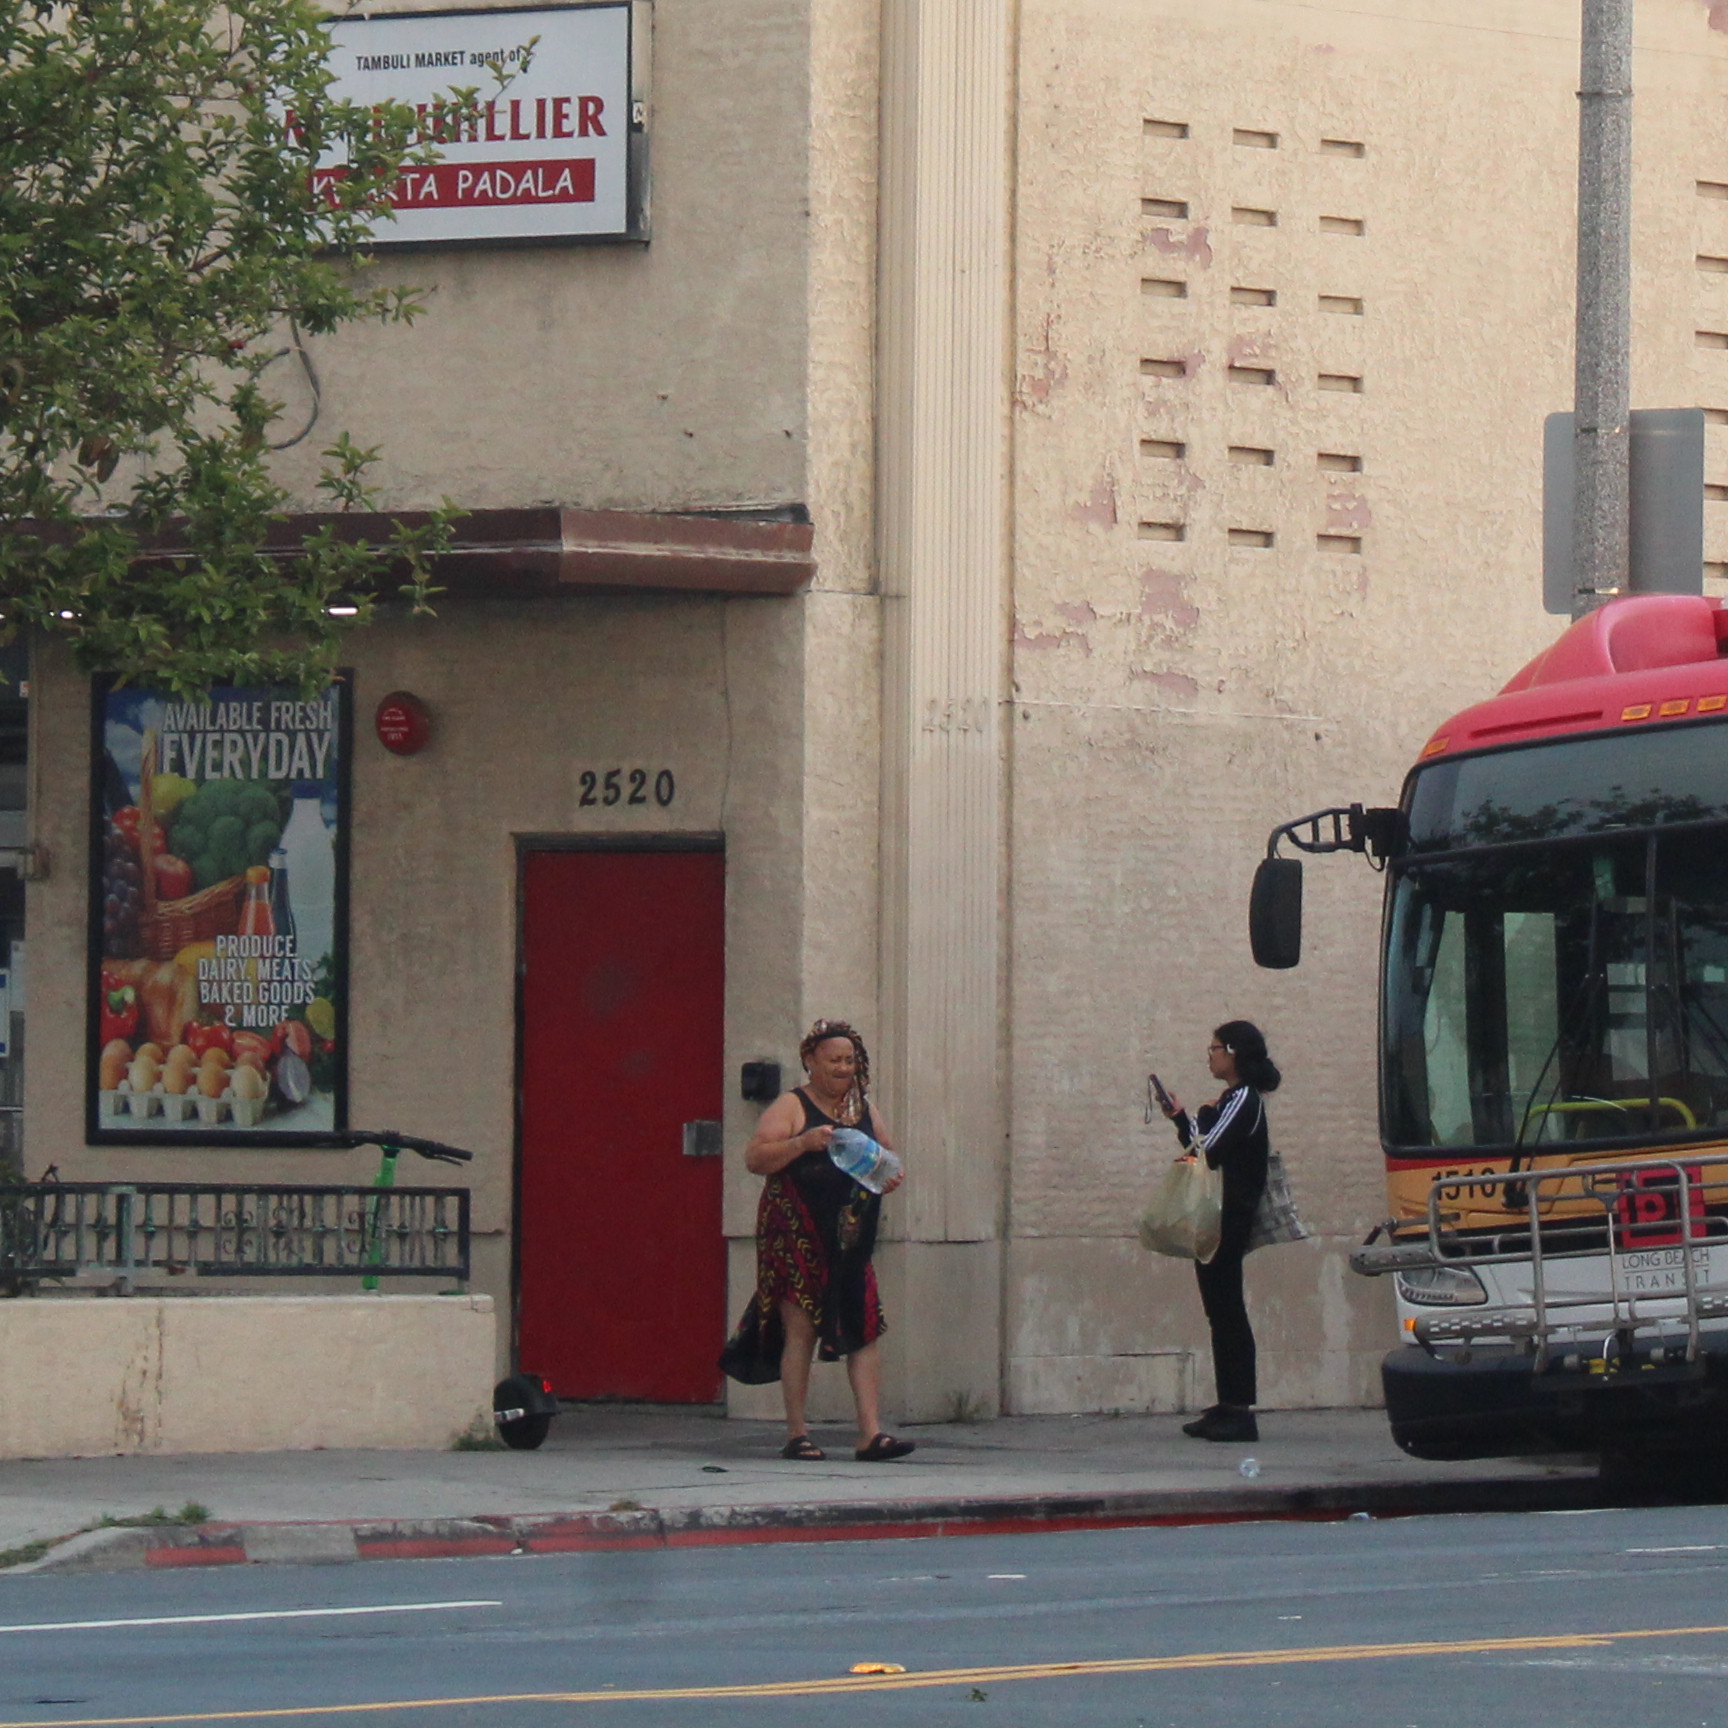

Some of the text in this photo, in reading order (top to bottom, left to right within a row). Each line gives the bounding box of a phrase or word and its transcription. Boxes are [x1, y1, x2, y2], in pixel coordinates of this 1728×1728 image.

[356, 48, 521, 71] TAMBULI MARKET agent of
[458, 168, 574, 199] PADALA
[162, 700, 333, 731] AVAILABLE FRESH
[161, 731, 333, 781] EVERYDAY
[579, 768, 675, 807] 2520
[200, 982, 316, 1004] BAKED GOODS
[243, 1005, 290, 1027] MORE
[1622, 1247, 1710, 1269] LONG BECH
